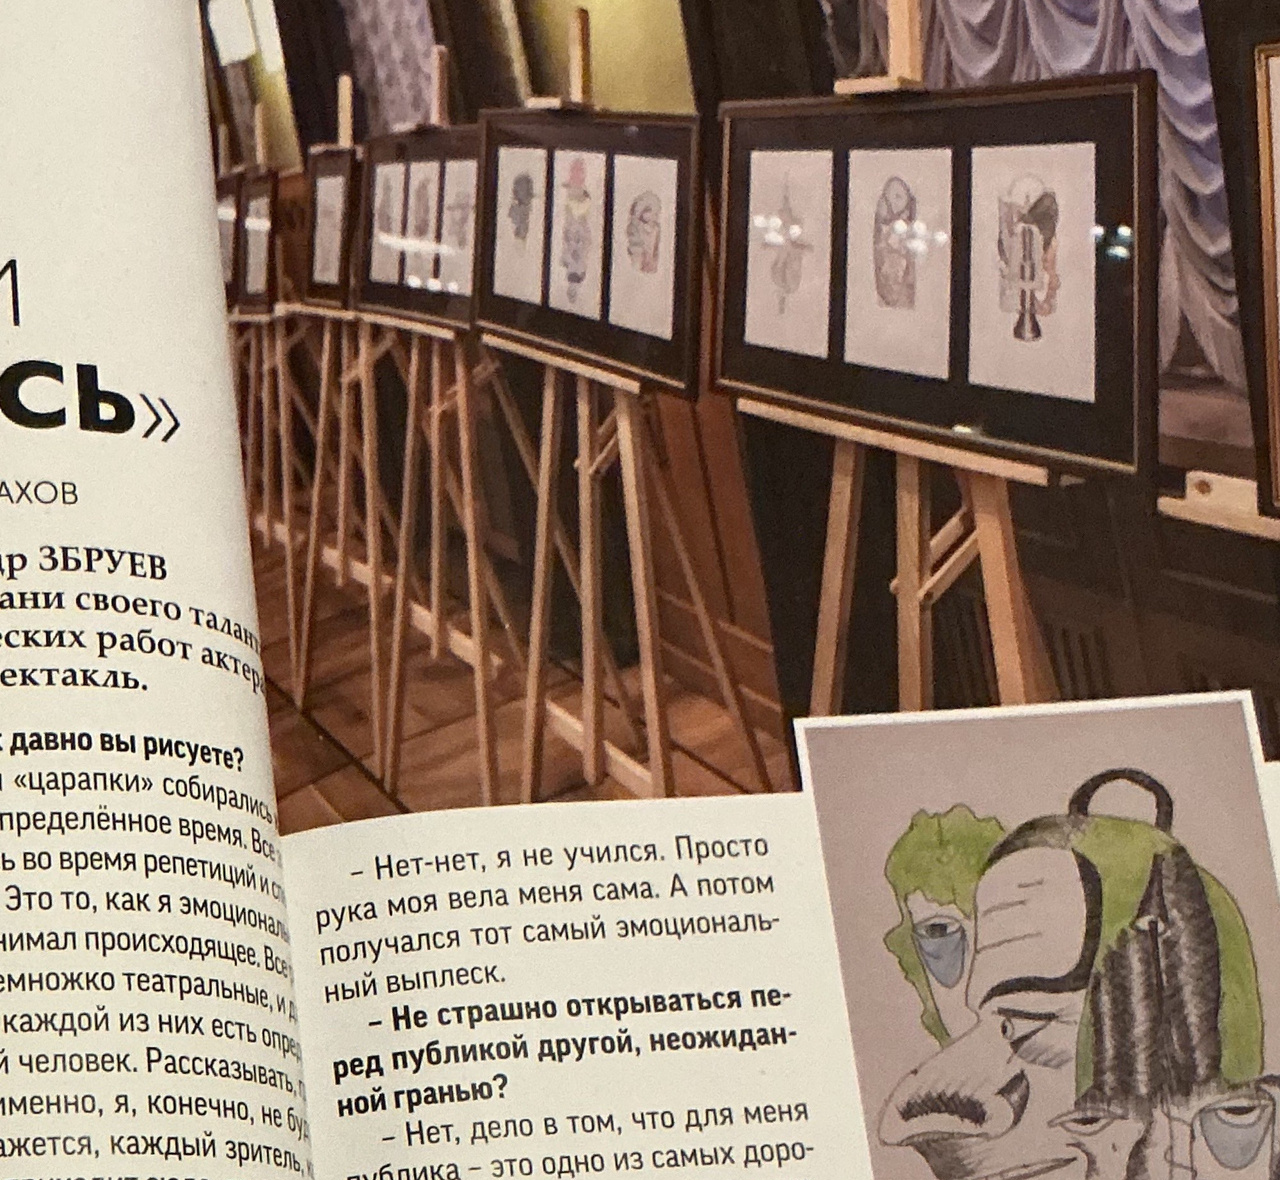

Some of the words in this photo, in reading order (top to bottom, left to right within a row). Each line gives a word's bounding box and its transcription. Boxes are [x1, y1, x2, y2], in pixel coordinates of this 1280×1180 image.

[38, 544, 168, 581] ЗБРУЕВ
[74, 591, 182, 622] своего
[95, 628, 193, 661] работ
[9, 731, 93, 757] давно
[99, 732, 137, 754] вы
[142, 735, 245, 773] рисуете?
[179, 819, 249, 849] время.
[319, 929, 461, 967] получался
[469, 925, 513, 947] тот
[522, 914, 607, 944] самый
[615, 913, 781, 941] эмоциональ-
[121, 971, 274, 1014] театральные,
[324, 970, 378, 1005] ный
[385, 964, 507, 994] выплеск.
[18, 1052, 139, 1074] человек.
[145, 1046, 298, 1098] Рассказывать,
[332, 1054, 385, 1086] ред
[391, 1033, 529, 1075] публикой
[537, 1027, 642, 1064] другой,
[649, 1026, 798, 1053] неожидан-
[336, 1085, 388, 1118] ной
[393, 1072, 509, 1114] гранью?
